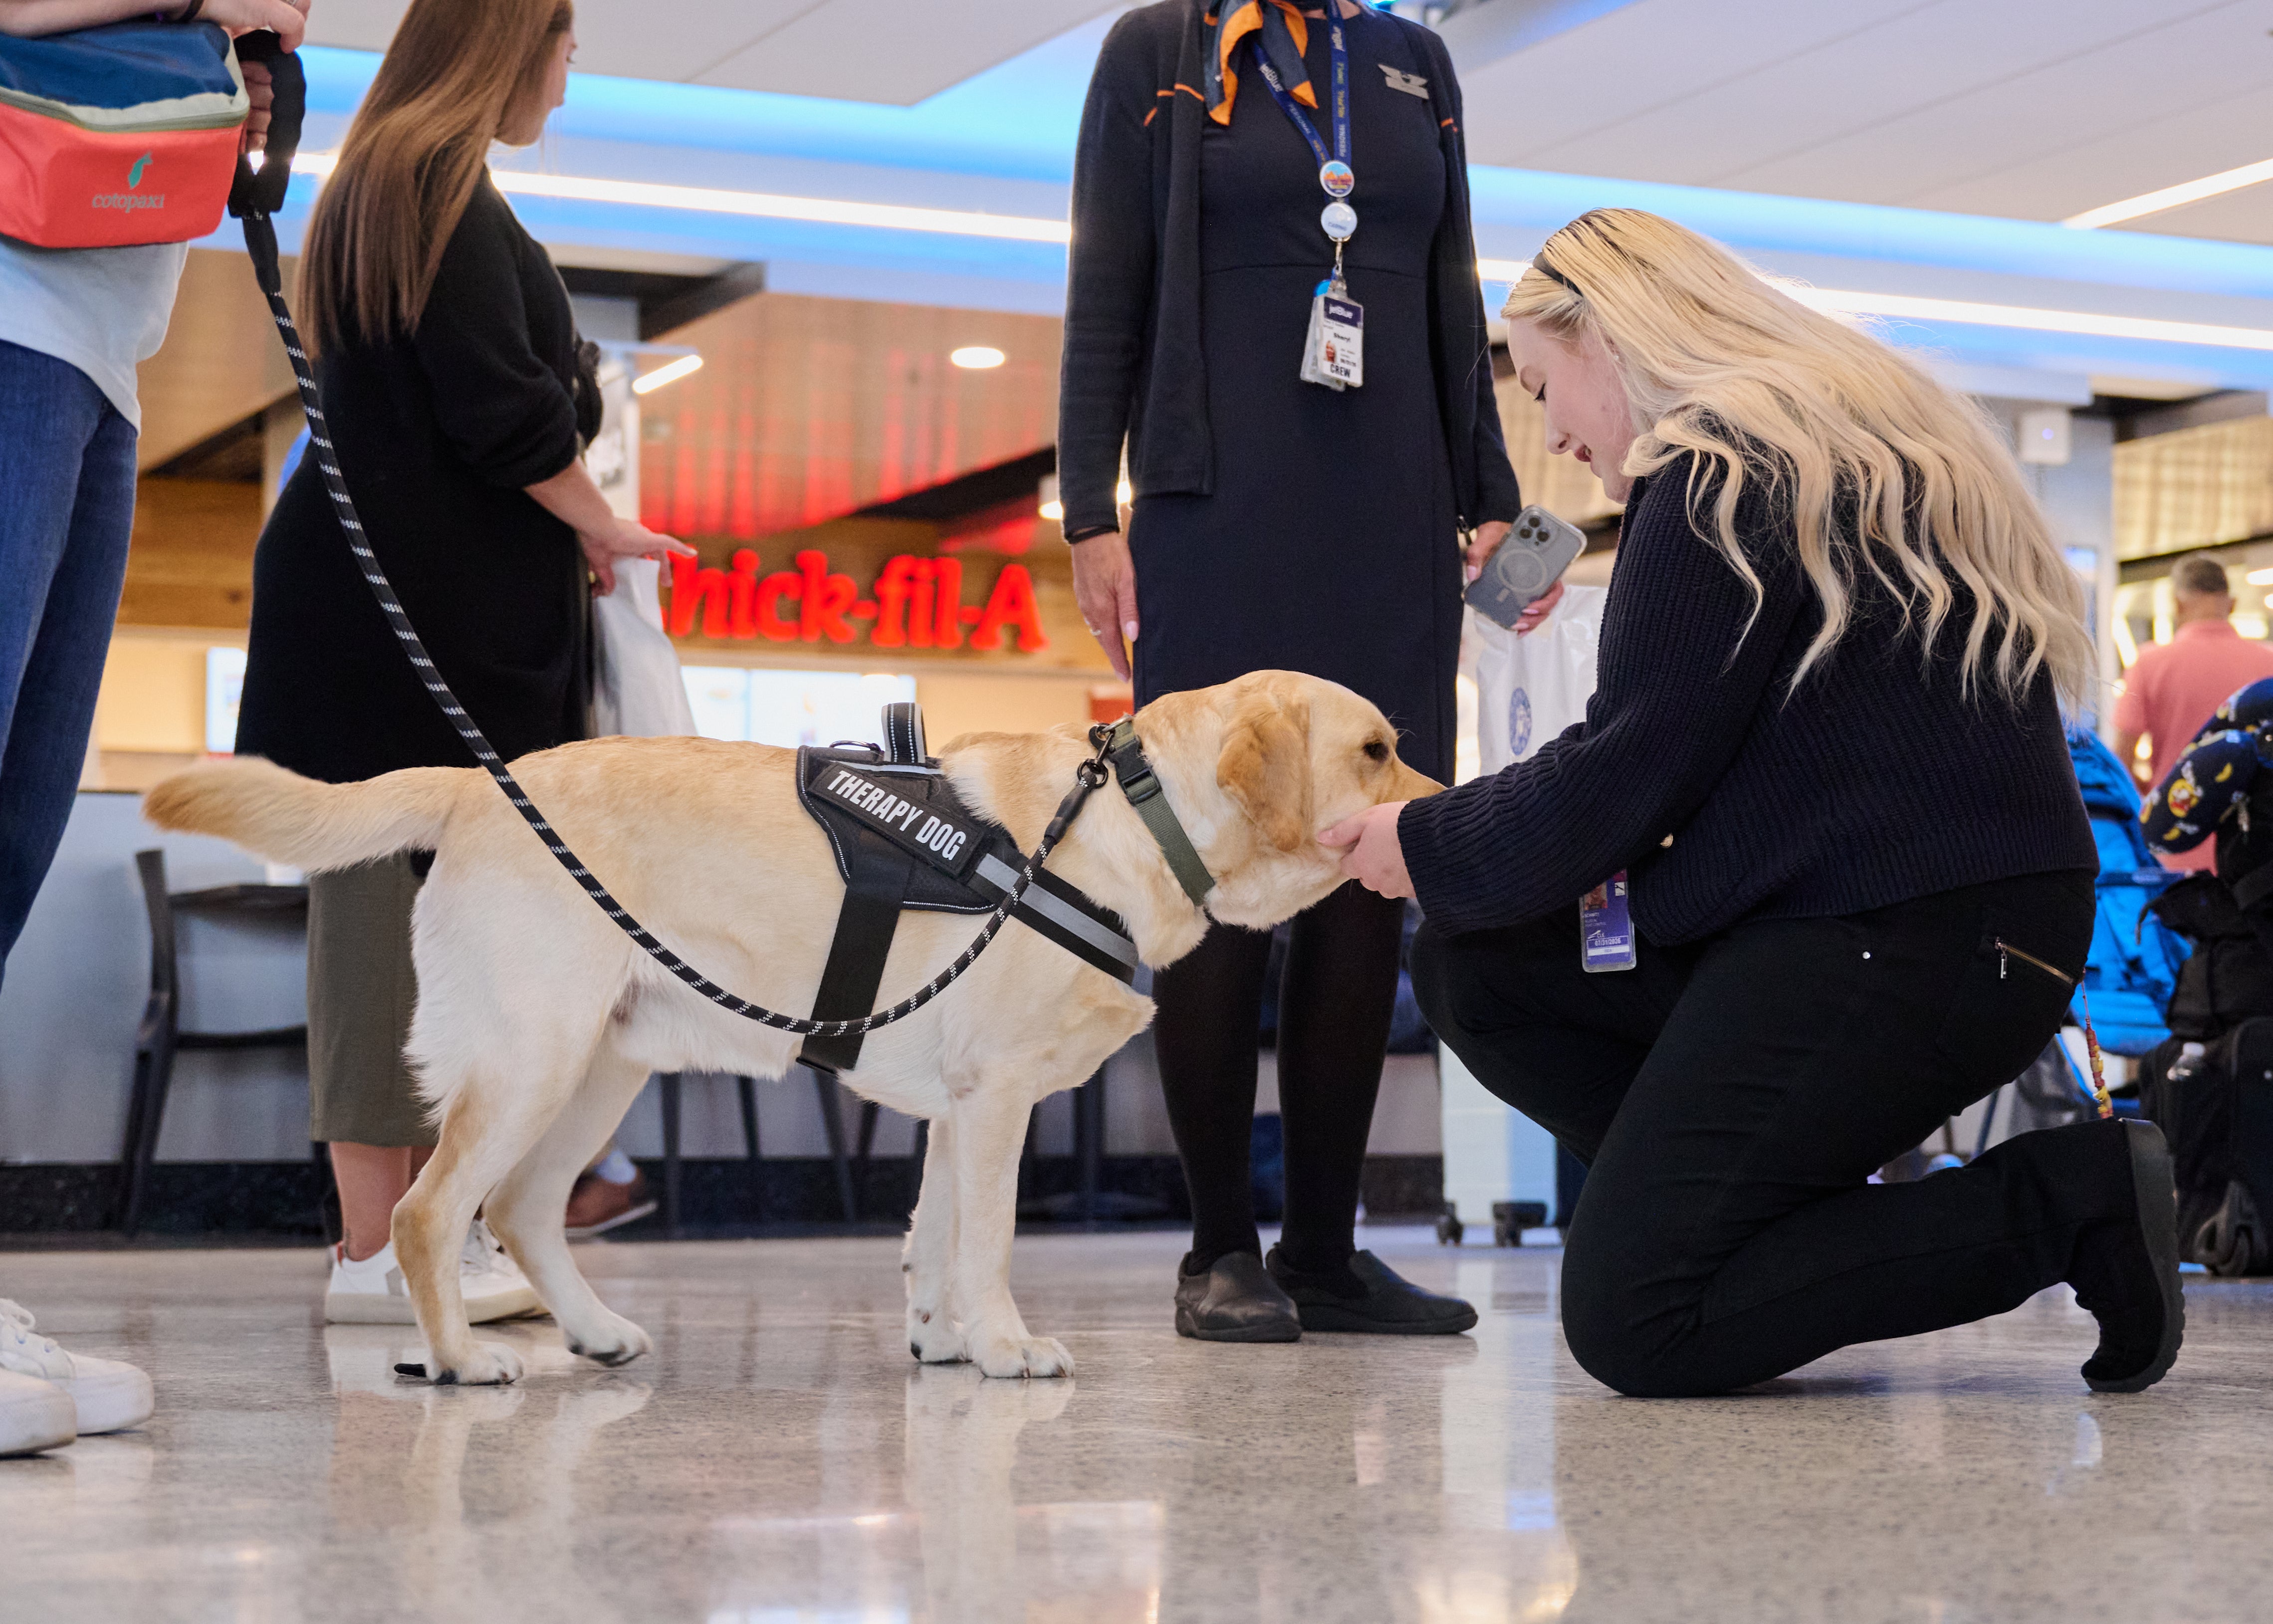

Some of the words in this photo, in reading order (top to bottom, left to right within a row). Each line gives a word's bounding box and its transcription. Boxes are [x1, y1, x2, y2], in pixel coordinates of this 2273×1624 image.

[1259, 62, 1284, 92] jetBlue
[92, 193, 165, 214] cotopaxi
[1329, 304, 1353, 319] jetBlue
[1330, 364, 1351, 378] CREW
[662, 545, 1050, 653] hick-fil-A
[827, 770, 920, 832] THERAPY
[915, 815, 966, 861] DOG
